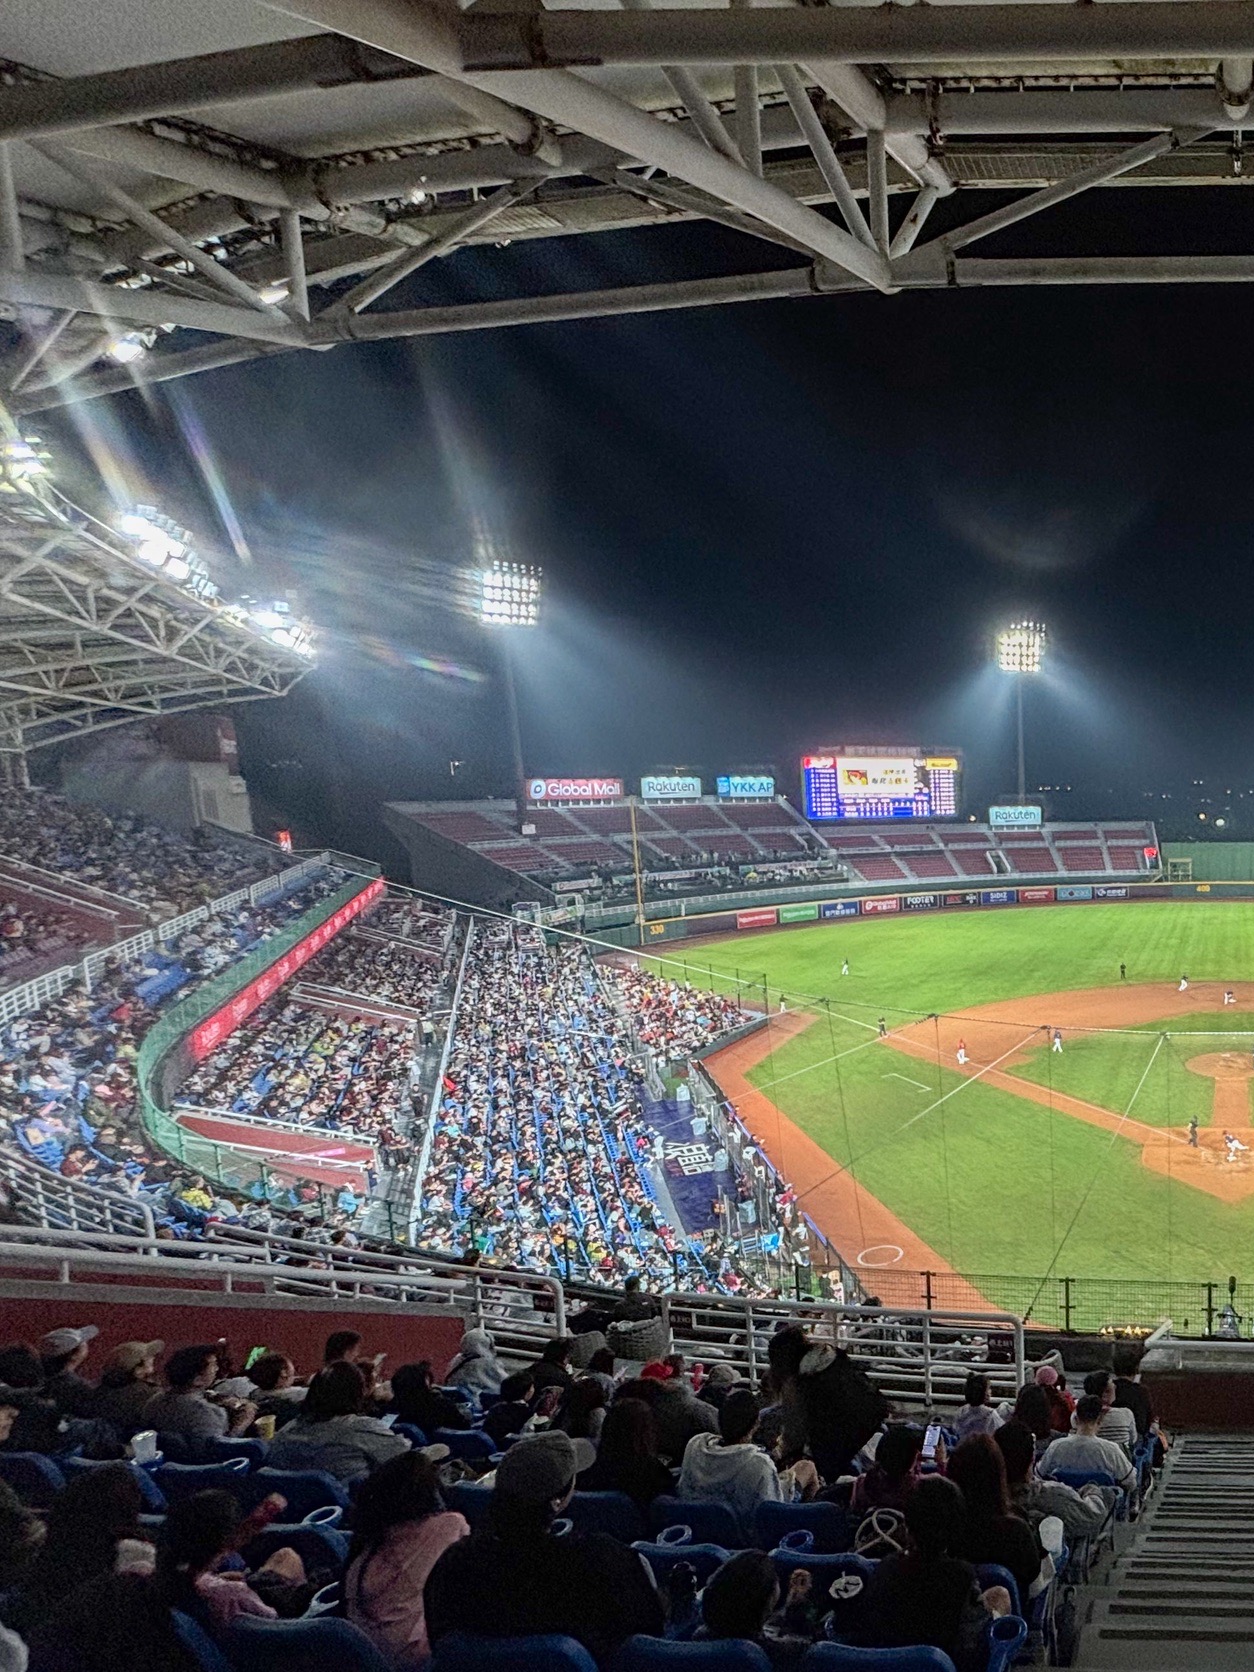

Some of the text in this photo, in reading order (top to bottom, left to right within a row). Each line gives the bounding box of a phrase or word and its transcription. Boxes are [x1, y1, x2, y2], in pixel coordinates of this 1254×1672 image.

[547, 782, 620, 796] Global Mall
[648, 781, 695, 795] Rakuten
[732, 782, 755, 793] YKK
[757, 782, 773, 792] AP
[995, 811, 1036, 822] Rakuten
[907, 896, 934, 905] FOOTER
[649, 924, 664, 935] 330
